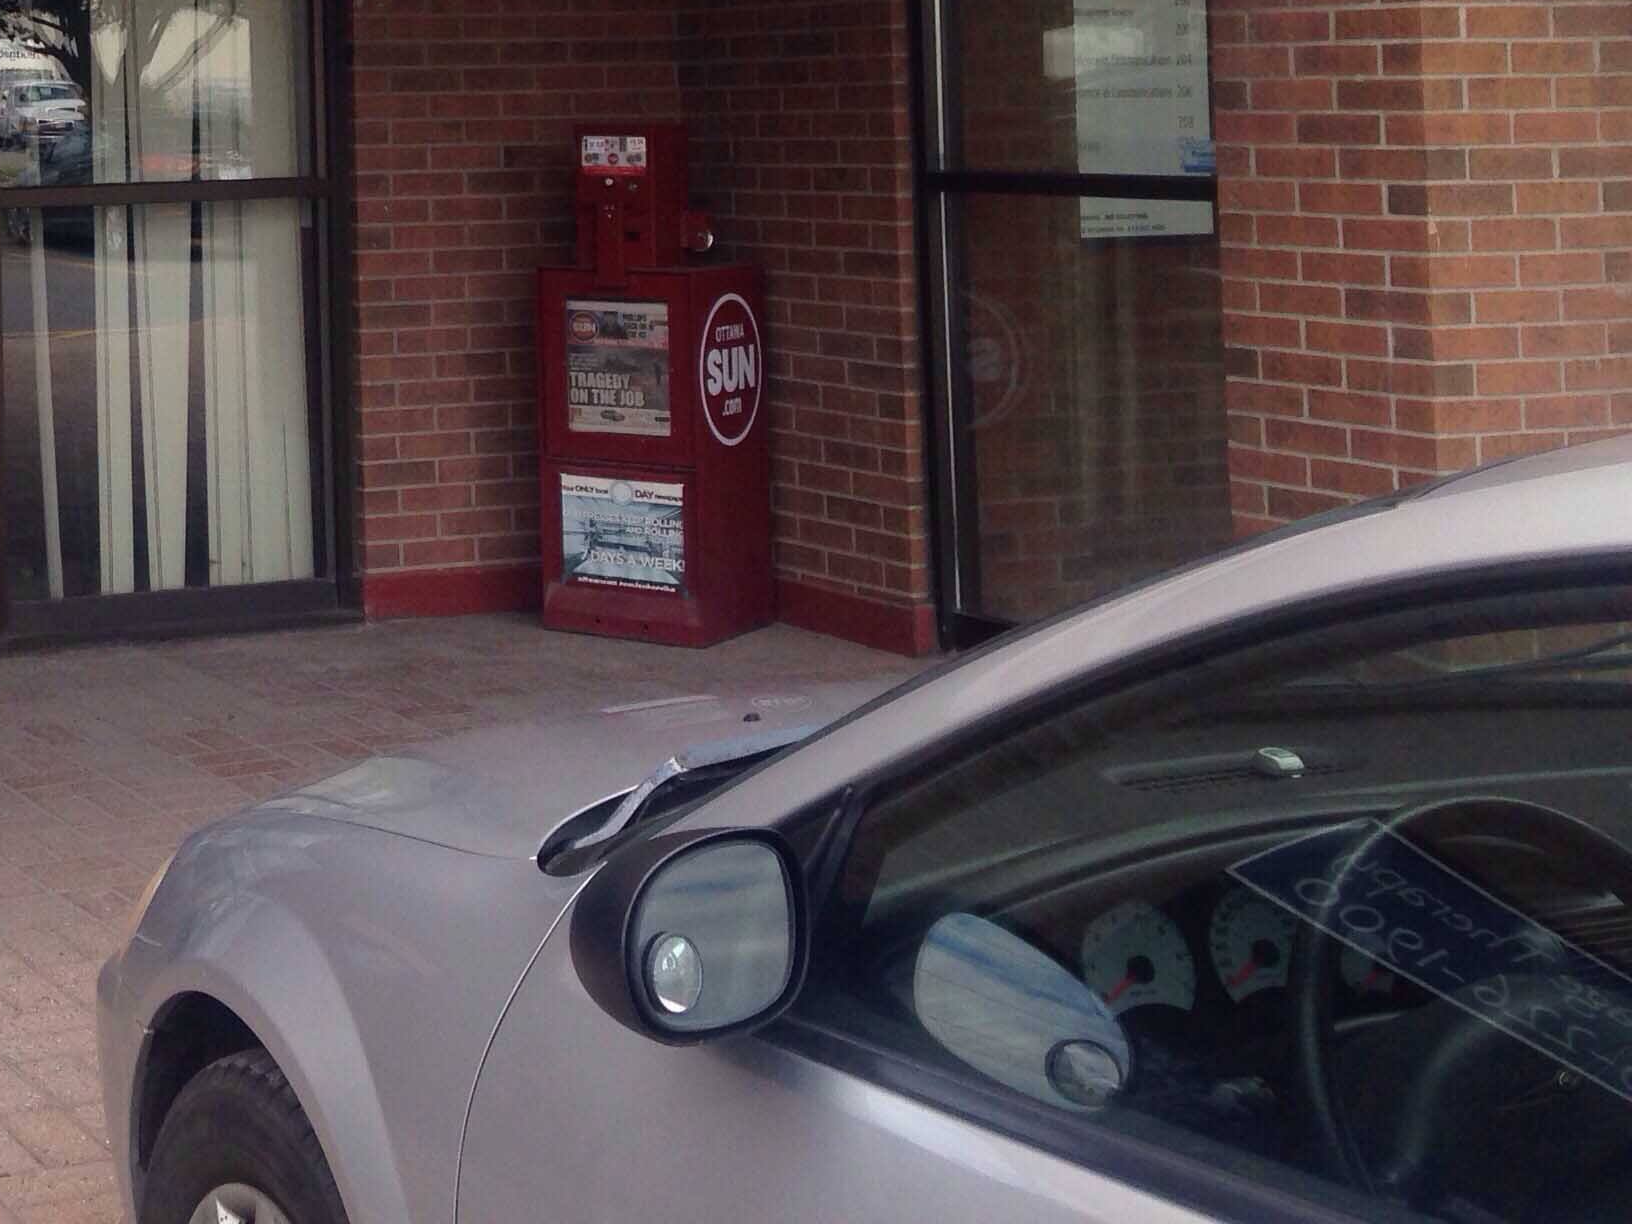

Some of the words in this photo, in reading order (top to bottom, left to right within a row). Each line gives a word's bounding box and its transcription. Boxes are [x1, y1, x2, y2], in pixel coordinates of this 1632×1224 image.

[715, 322, 745, 343] OTTAWA
[569, 371, 631, 390] TRAGEDY
[707, 344, 756, 397] SUN
[570, 388, 589, 404] ON
[591, 389, 617, 406] THE
[620, 390, 646, 408] JOB
[635, 489, 654, 499] DAY
[590, 551, 624, 564] DAYS
[640, 557, 685, 572] WEEK!
